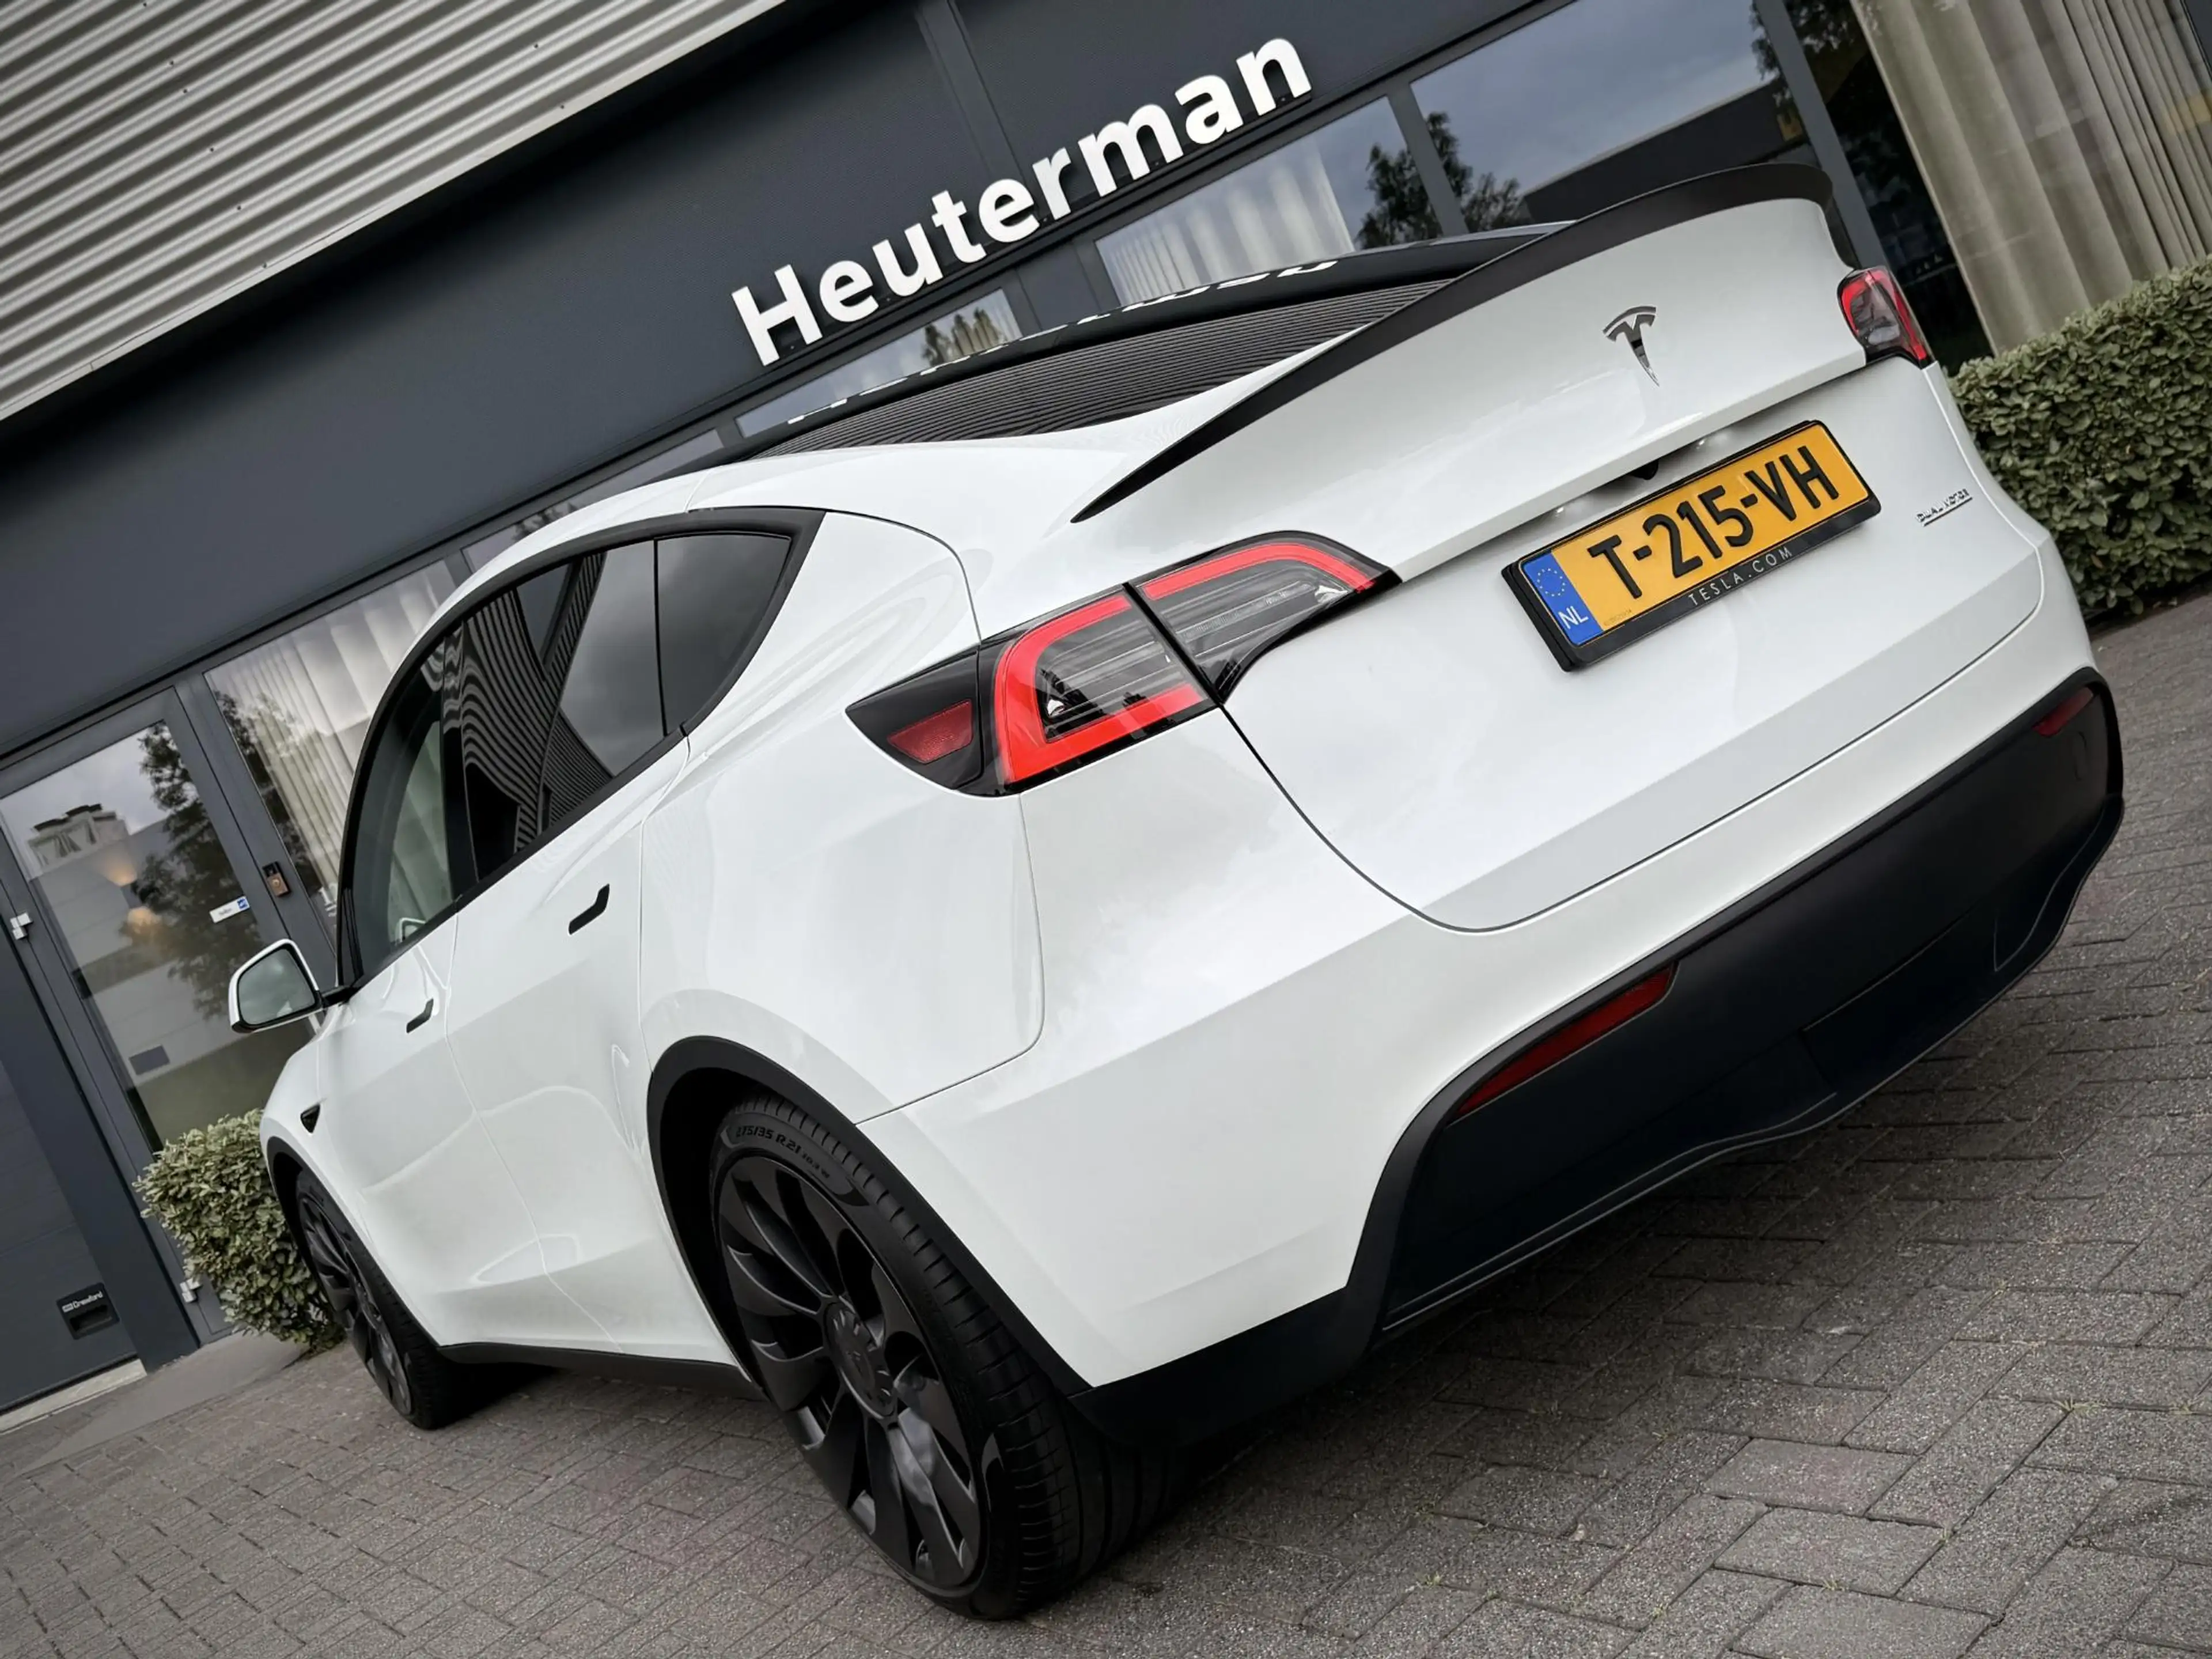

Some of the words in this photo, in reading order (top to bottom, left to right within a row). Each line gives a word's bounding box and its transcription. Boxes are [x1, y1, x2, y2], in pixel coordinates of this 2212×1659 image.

[732, 37, 1312, 367] Heuterman
[1586, 445, 1839, 599] T-215-VH
[1558, 605, 1589, 630] NL
[1688, 546, 1793, 605] TESLA.COM
